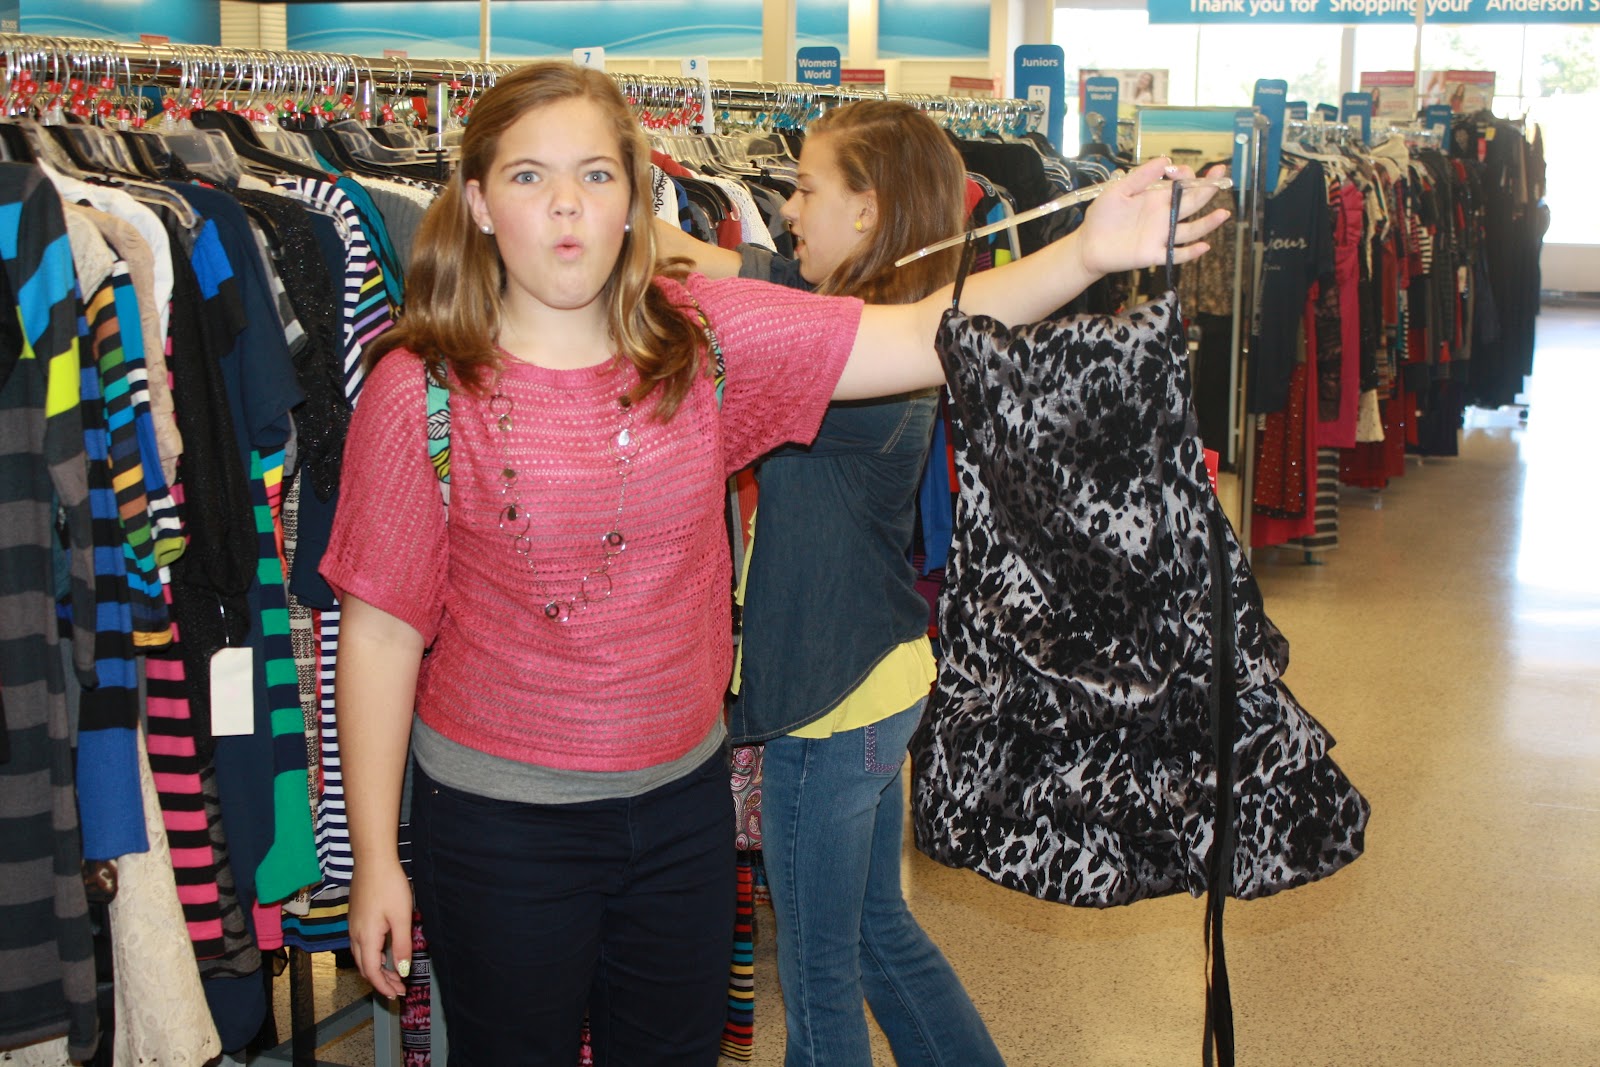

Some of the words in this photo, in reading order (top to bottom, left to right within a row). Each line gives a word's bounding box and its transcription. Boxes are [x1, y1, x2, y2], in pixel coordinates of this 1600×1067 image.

[1190, 0, 1245, 13] Thank
[1249, 0, 1285, 17] you
[1291, 0, 1318, 12] for
[1426, 0, 1472, 16] your
[1485, 0, 1583, 11] Anderson
[1589, 0, 1600, 11] S
[584, 52, 591, 63] 7
[1021, 57, 1058, 67] Juniors
[690, 60, 697, 70] 9
[798, 58, 837, 68] Womens
[804, 70, 832, 79] World
[1034, 88, 1044, 96] 11
